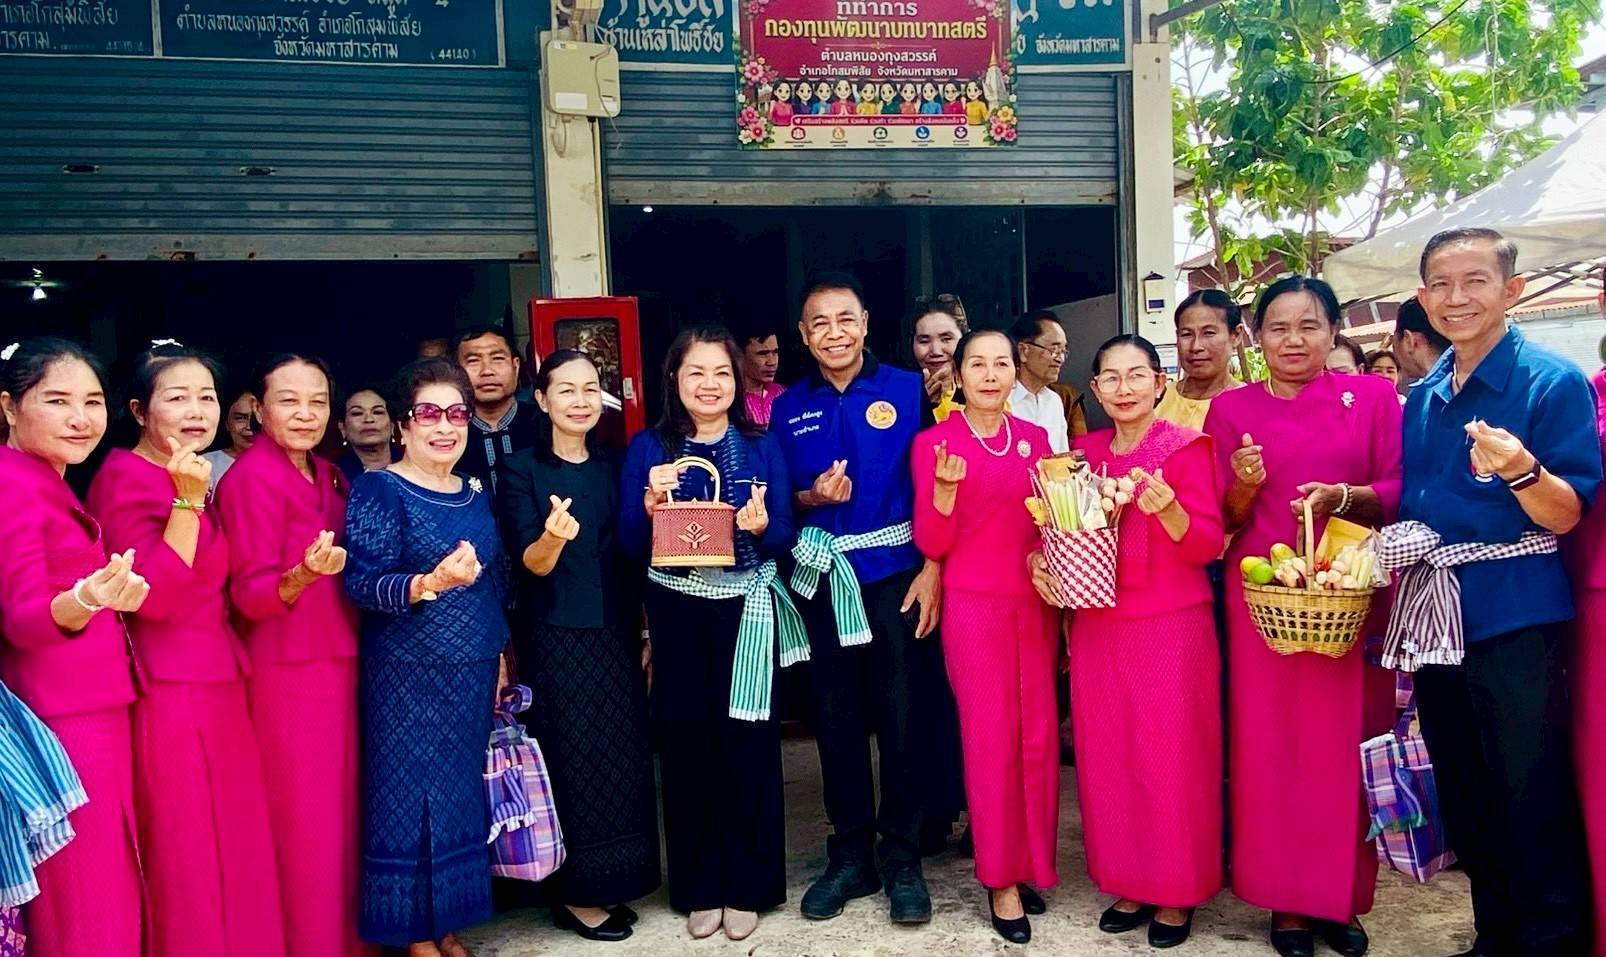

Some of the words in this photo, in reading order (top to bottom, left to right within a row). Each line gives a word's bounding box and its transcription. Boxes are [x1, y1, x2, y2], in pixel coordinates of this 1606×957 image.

[837, 0, 918, 16] ททำการ
[176, 4, 310, 39] ตำบลหนองกุงสวรรค์
[318, 10, 422, 41] อำเภอโกสุมพิสัย
[765, 15, 988, 44] กองทุนพัฒนาบทบาทสตรี
[273, 35, 399, 59] จังหวัดมหาสารคาม
[1035, 32, 1120, 54] จังหวัดมหาสารคาม
[821, 48, 937, 66] ตำบลหนองกุงสวรรค์
[877, 65, 958, 77] จังหวัดมหาสารคาม
